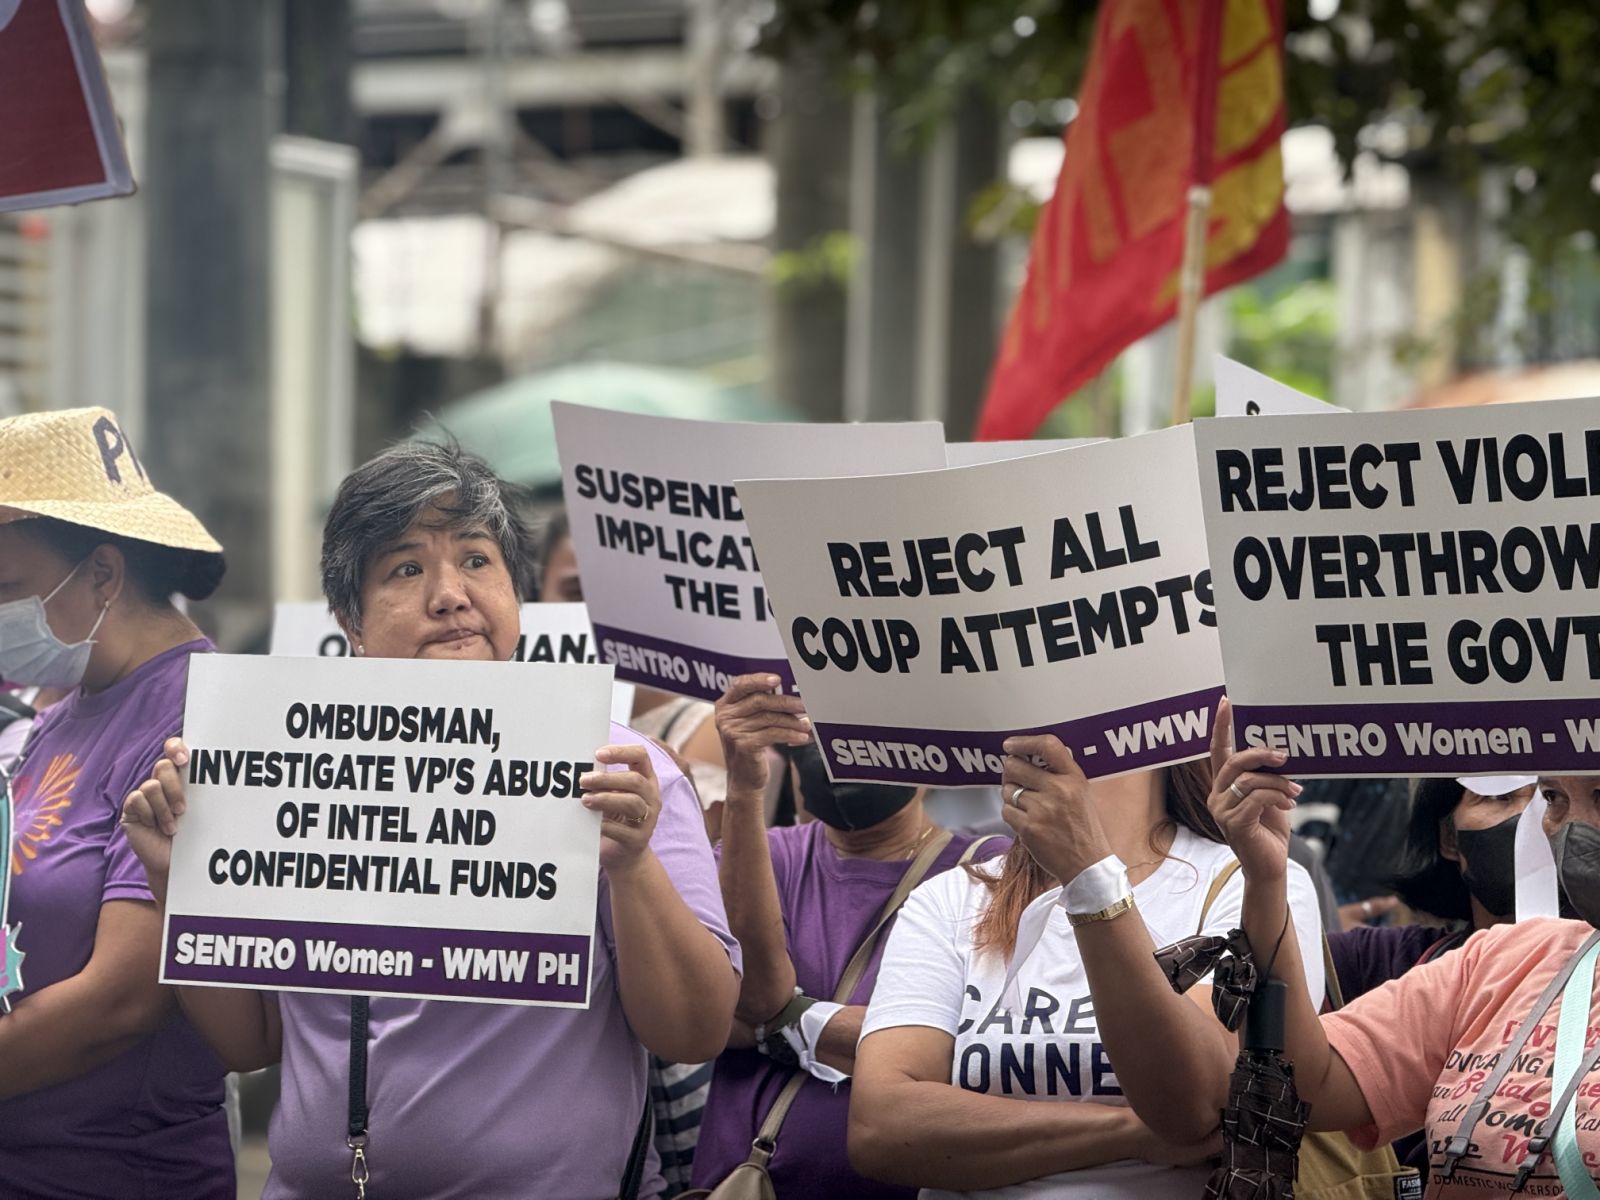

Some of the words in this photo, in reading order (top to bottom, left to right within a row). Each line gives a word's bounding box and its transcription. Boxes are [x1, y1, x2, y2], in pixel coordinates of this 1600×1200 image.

[575, 464, 745, 521] SUSPEND
[1215, 442, 1421, 512] REJECT
[827, 526, 1026, 598] REJECT
[1050, 504, 1161, 579] ALL
[1233, 523, 1600, 601] OVERTHROW
[664, 574, 741, 620] THE
[791, 616, 920, 674] COUP
[940, 569, 1218, 674] ATTEMPTS
[602, 639, 690, 683] SENTRO
[1315, 622, 1433, 686] THE
[1447, 615, 1600, 686] GOVT
[286, 702, 500, 752] OMBUDSMAN,
[831, 738, 947, 773] SENTRO
[1083, 745, 1097, 756] -
[1104, 706, 1209, 758] WMW
[1244, 722, 1387, 757] SENTRO
[1394, 722, 1533, 757] Women
[1542, 733, 1557, 743] -
[189, 749, 395, 792] INVESTIGATE
[405, 756, 475, 795] VP'S
[483, 760, 593, 799] ABUSE
[276, 801, 320, 838] OF
[328, 804, 417, 843] INTEL
[426, 808, 496, 846] AND
[208, 848, 440, 894] CONFIDENTIAL
[450, 860, 557, 900] FUNDS
[175, 932, 296, 970] SENTRO
[305, 939, 413, 977] Women
[421, 958, 433, 968] -
[442, 947, 529, 983] WMW
[538, 952, 580, 986] PH
